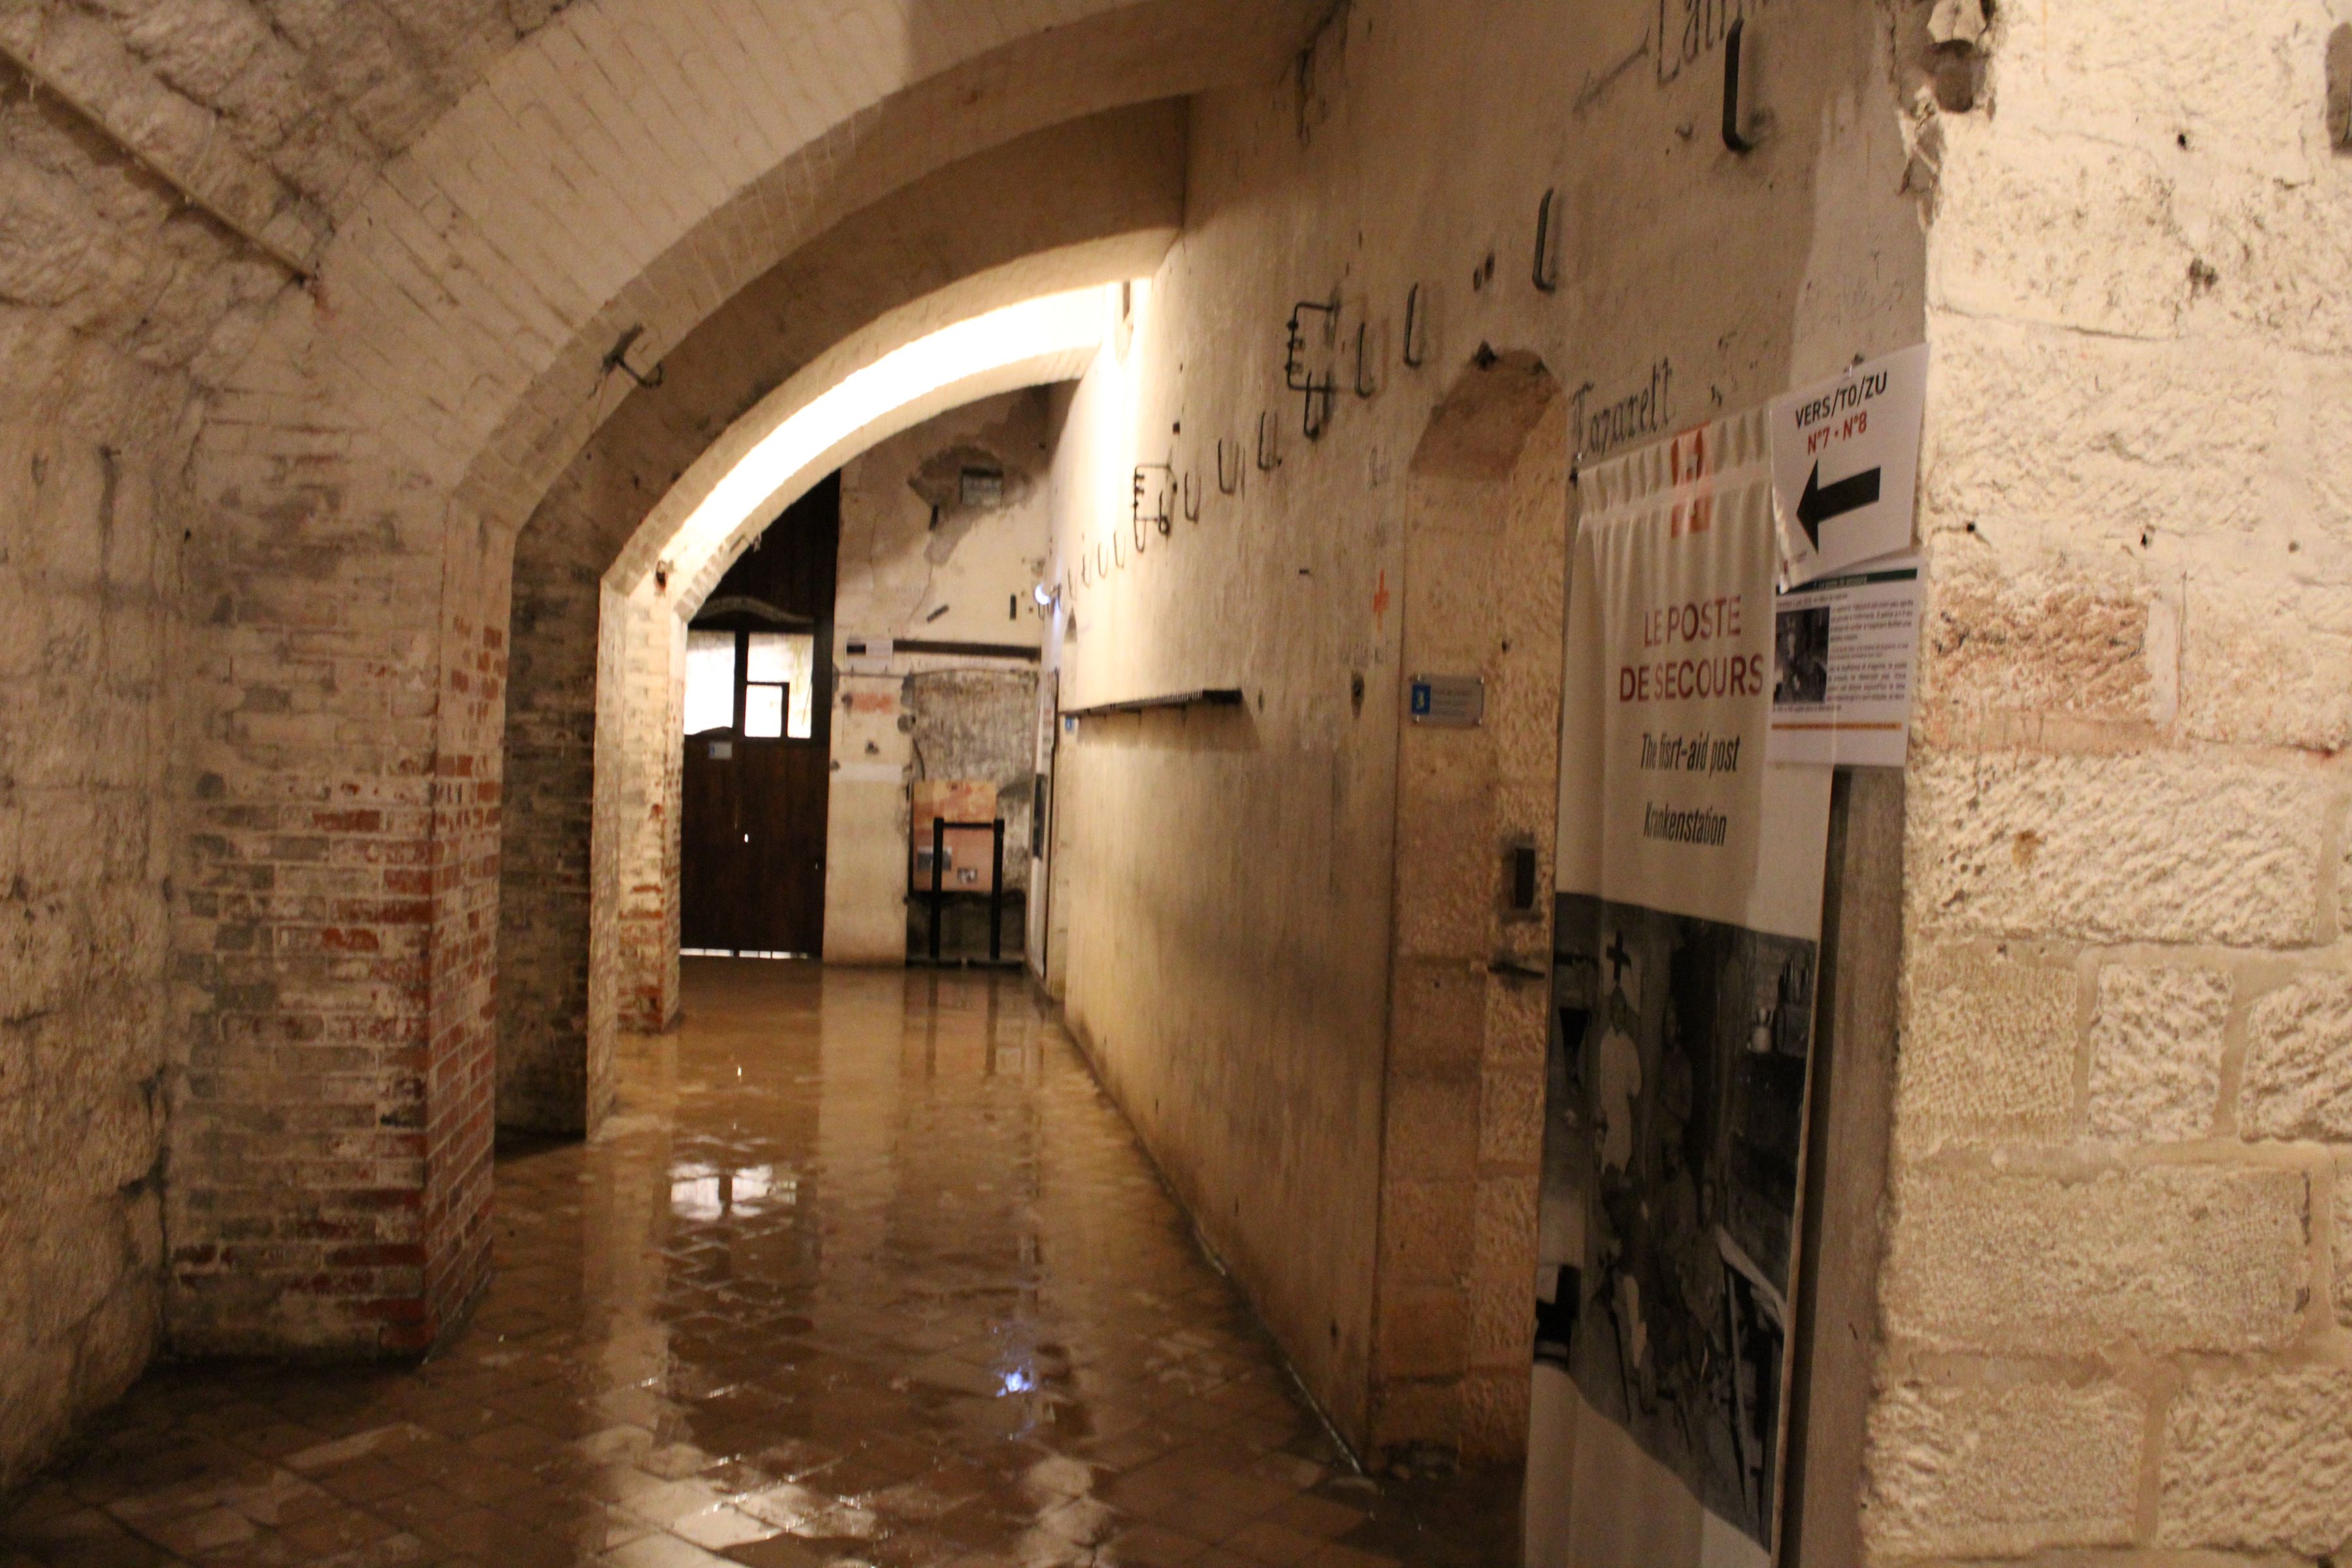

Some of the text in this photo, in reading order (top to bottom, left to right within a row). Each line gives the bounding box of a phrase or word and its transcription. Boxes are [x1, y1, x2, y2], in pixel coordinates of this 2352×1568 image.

[1795, 370, 1887, 429] VERS/TO/ZU
[1644, 595, 1741, 648] LE POSTE
[1620, 653, 1764, 702] DE SECOURS
[1641, 732, 1658, 770] The
[1708, 734, 1741, 779] post
[1643, 801, 1727, 847] Krankenstation
